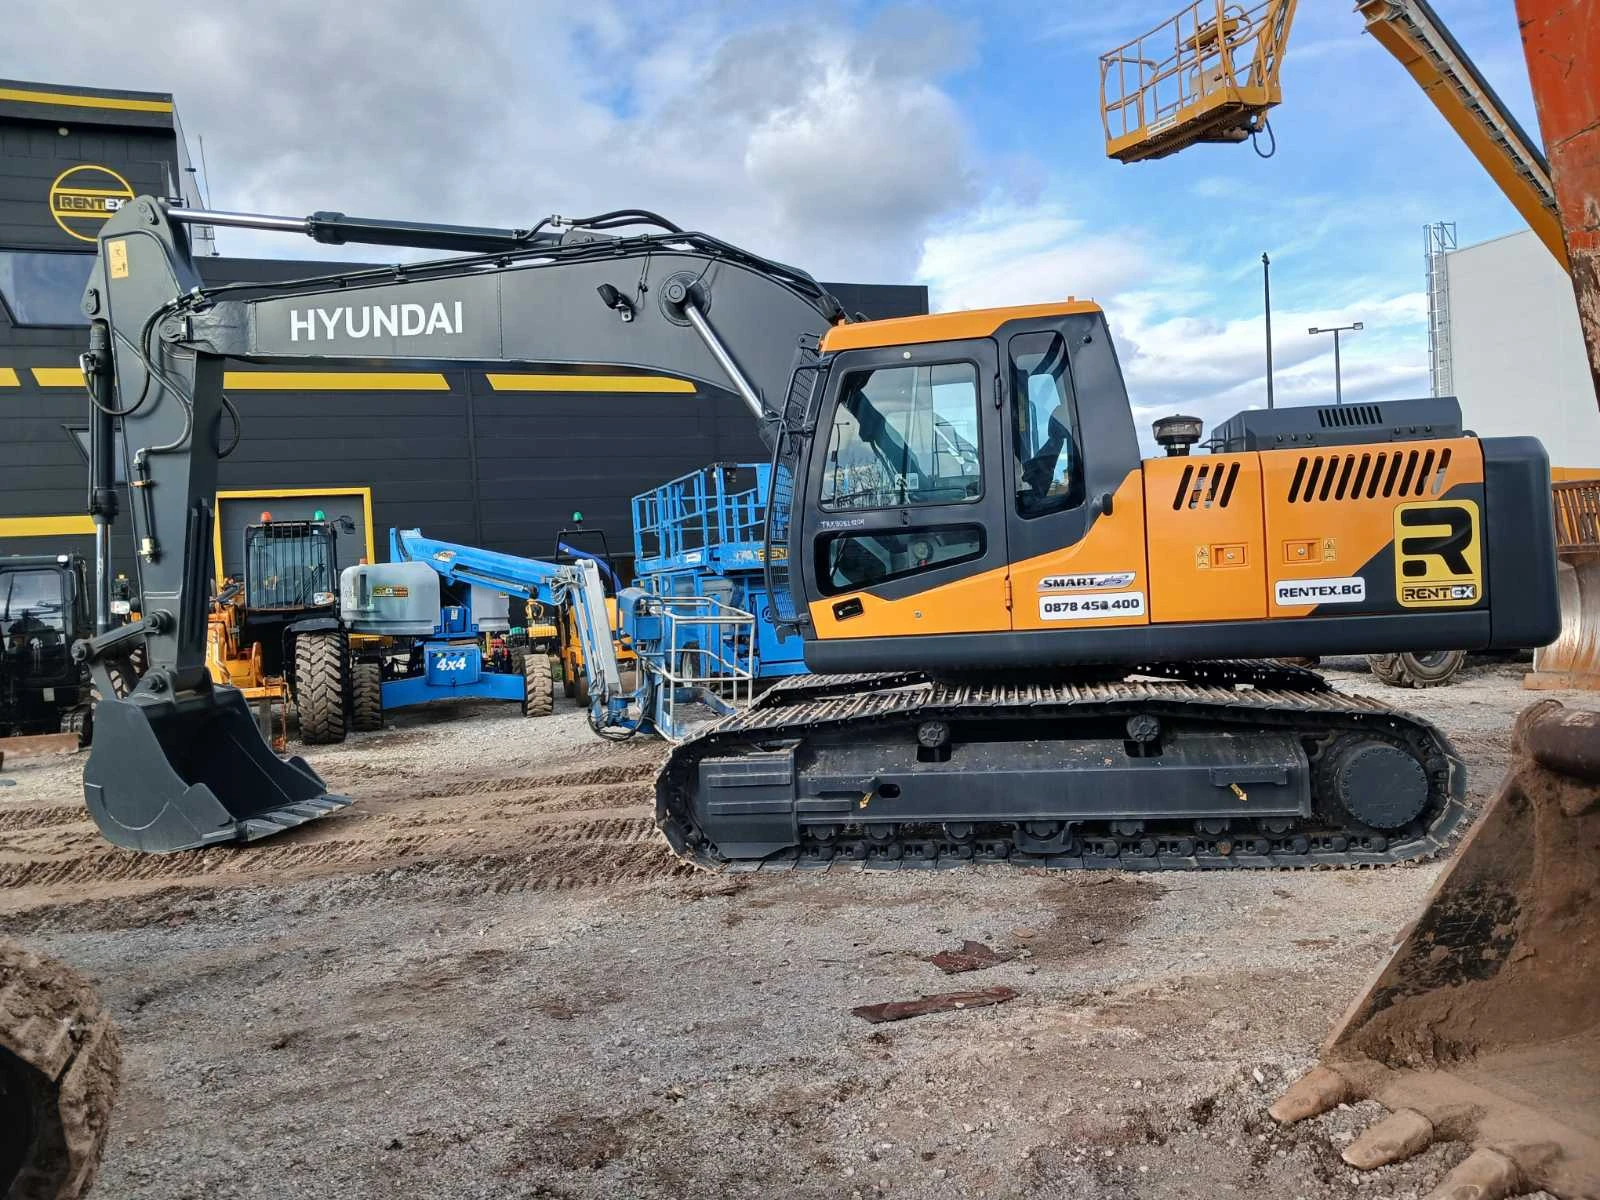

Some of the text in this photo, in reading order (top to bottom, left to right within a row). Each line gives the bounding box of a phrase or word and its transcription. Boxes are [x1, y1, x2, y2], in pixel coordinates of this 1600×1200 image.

[290, 301, 463, 342] HYUNDAI
[1043, 577, 1096, 588] SMART
[1278, 584, 1362, 599] RENTEX.BG
[1404, 585, 1474, 600] RENTEX
[1044, 601, 1078, 613] 0878
[1111, 598, 1140, 609] 400
[436, 657, 467, 671] 4x4
